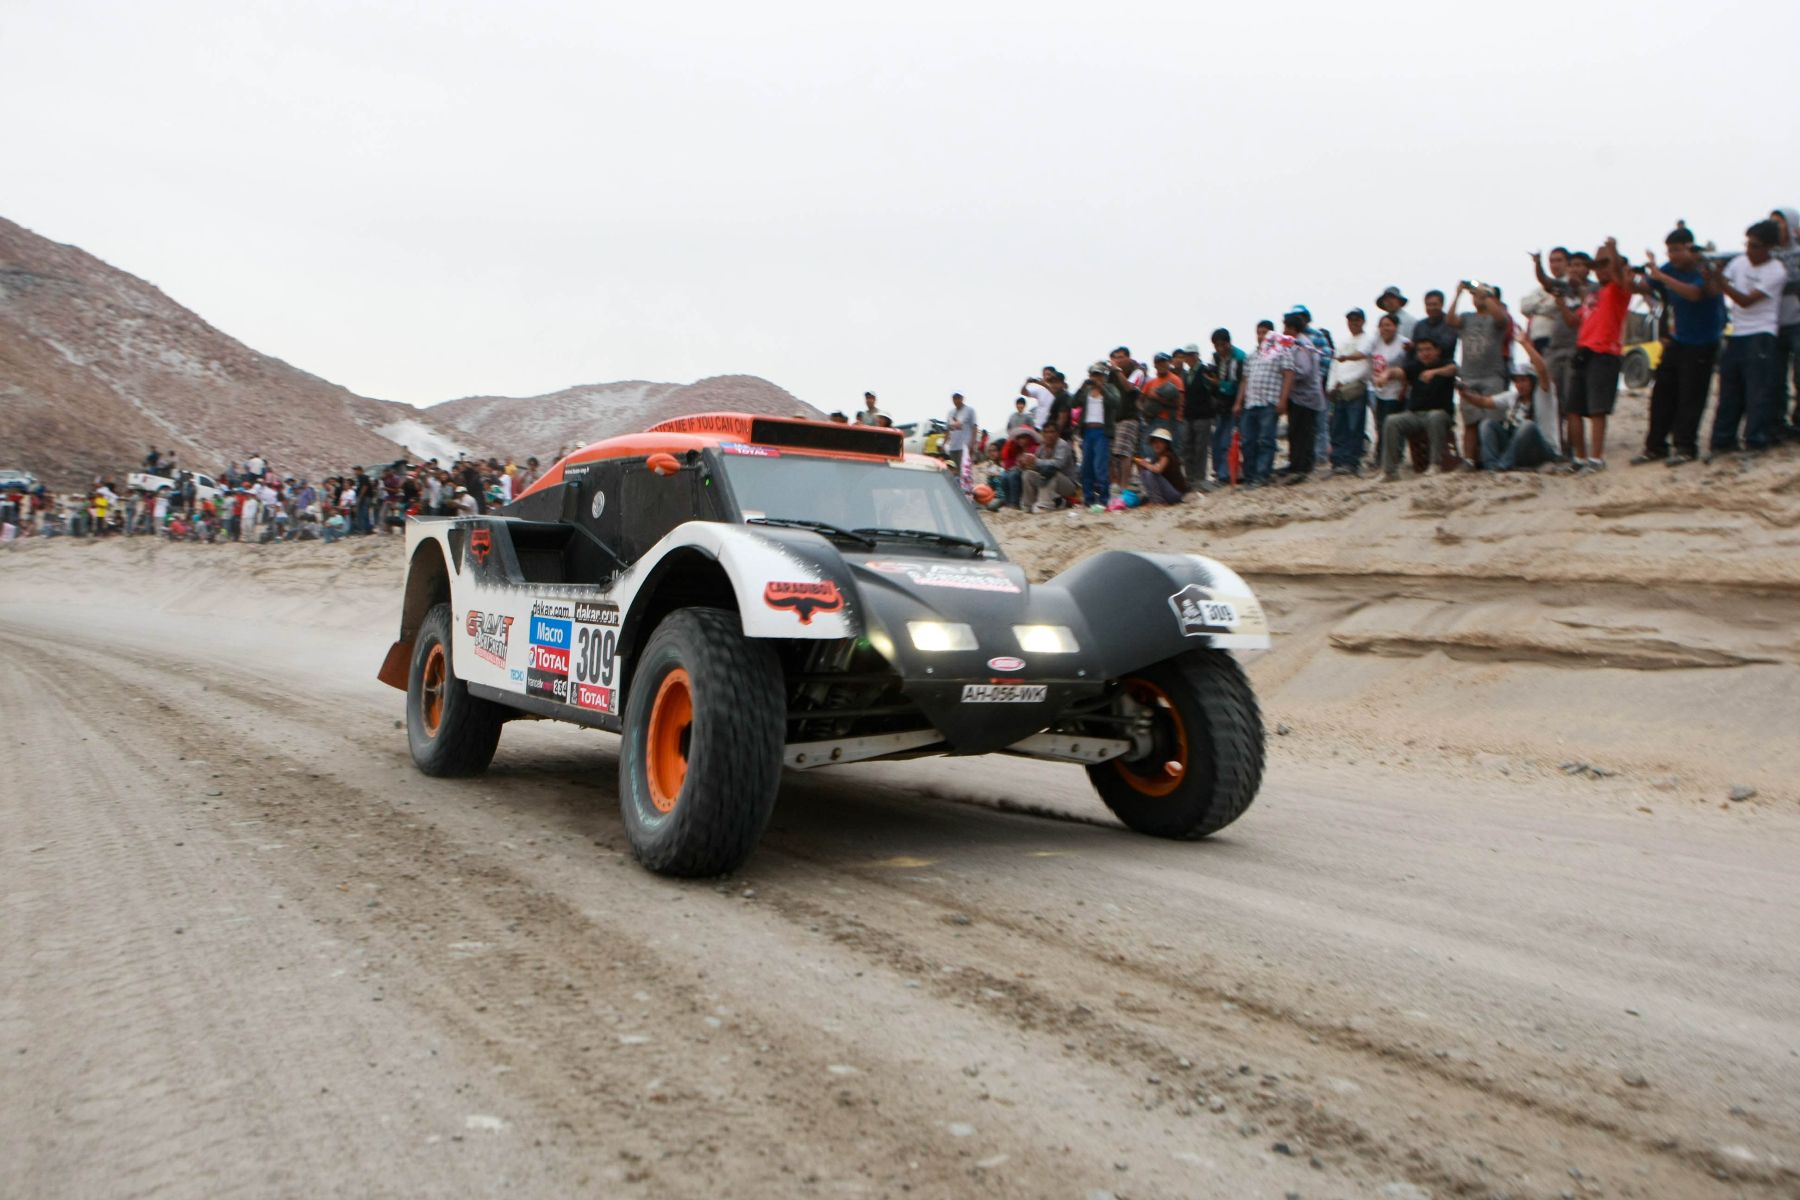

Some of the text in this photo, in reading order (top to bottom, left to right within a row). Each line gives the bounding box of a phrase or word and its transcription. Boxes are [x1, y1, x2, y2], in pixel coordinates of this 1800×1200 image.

[676, 419, 687, 432] ME
[688, 417, 695, 431] IF
[697, 415, 714, 430] YOU
[715, 416, 734, 432] CAN
[533, 600, 570, 619] dakar.com
[576, 604, 619, 624] dakar.com
[536, 621, 564, 644] Macro
[537, 647, 568, 672] TOTAL
[576, 626, 616, 687] 309
[580, 687, 608, 708] TOTAL
